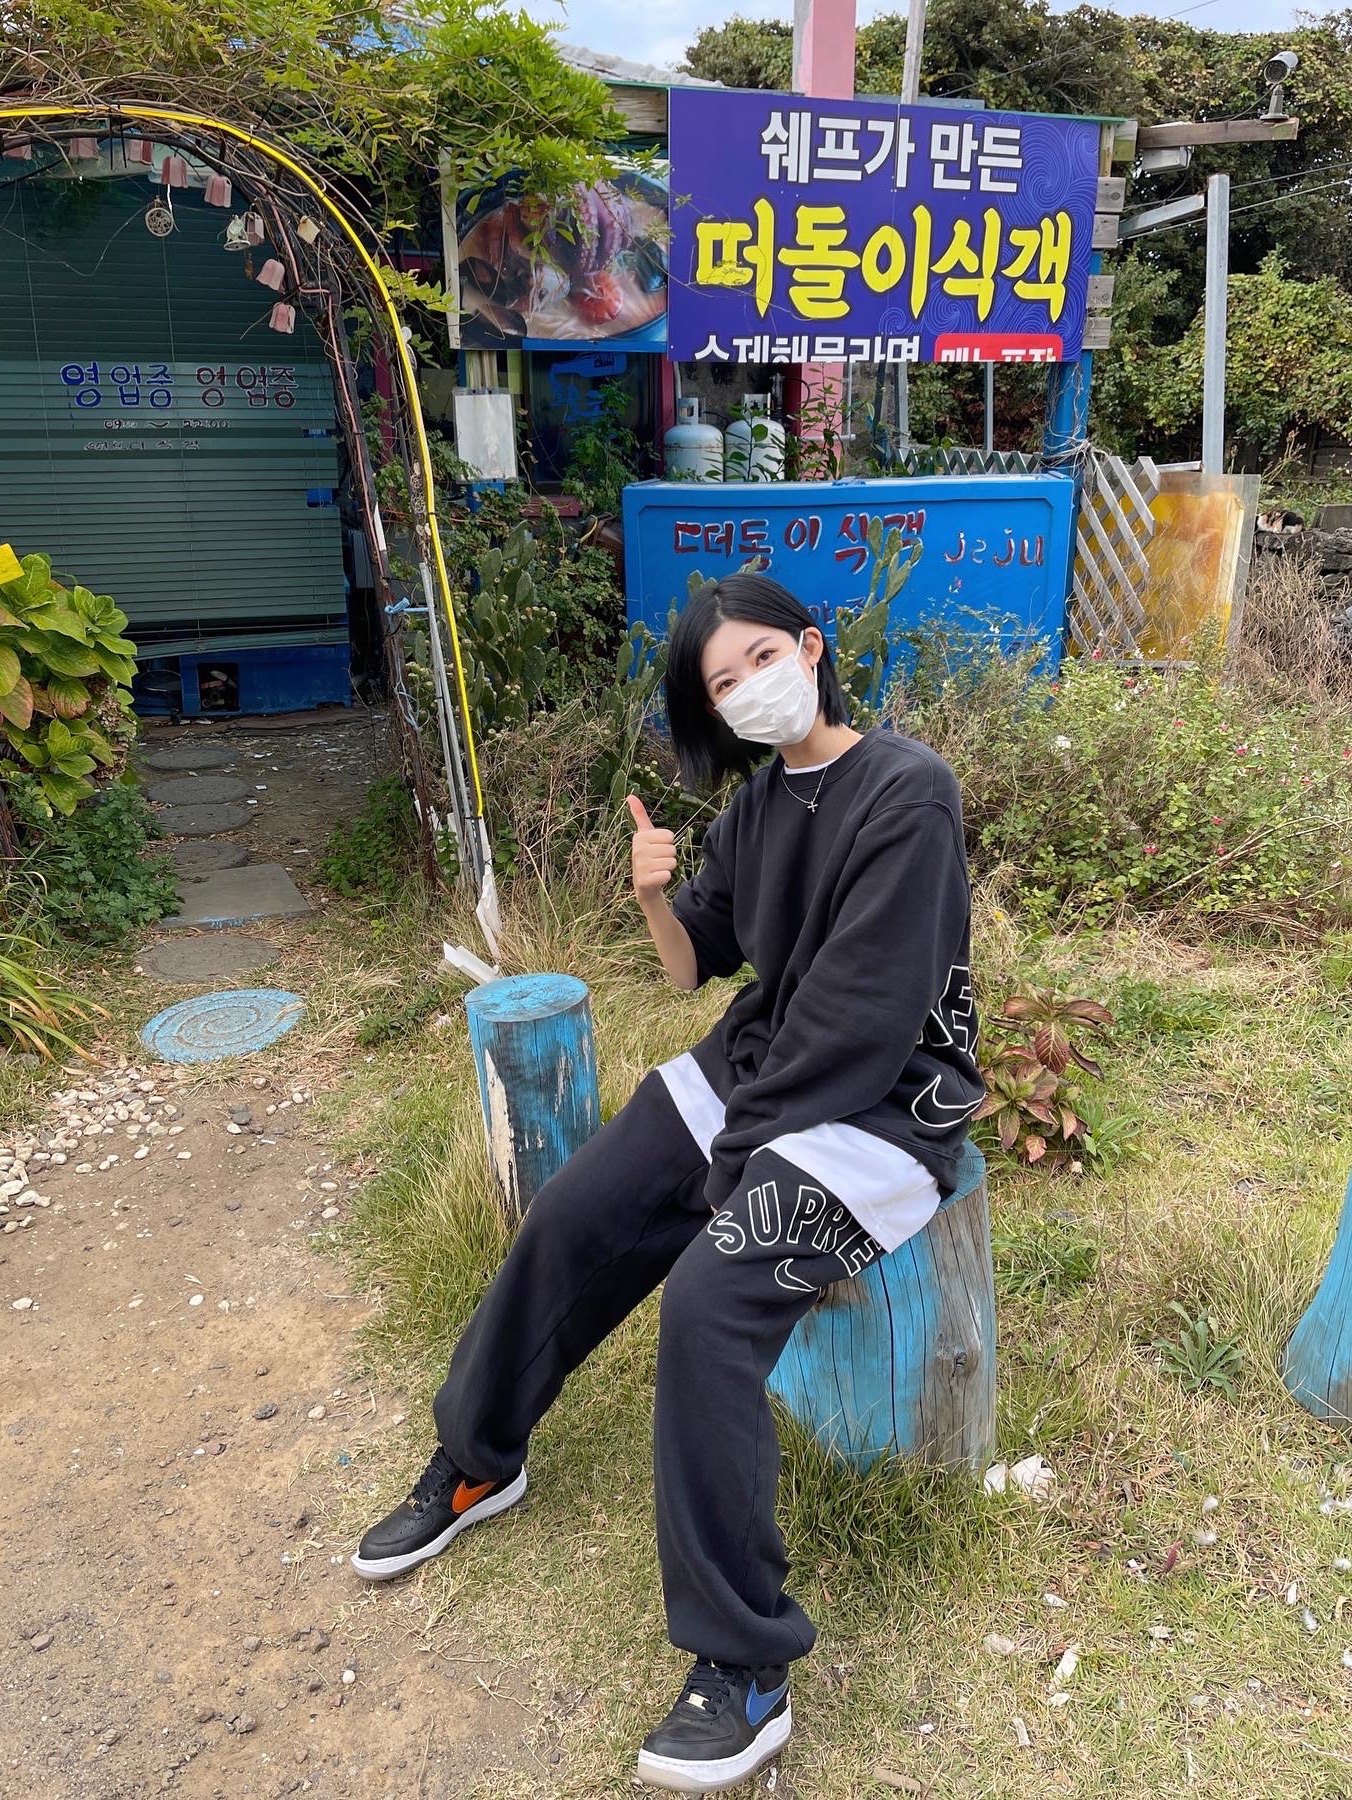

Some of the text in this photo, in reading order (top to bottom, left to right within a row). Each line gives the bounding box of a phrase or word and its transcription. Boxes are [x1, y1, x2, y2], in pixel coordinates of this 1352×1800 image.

[761, 111, 1023, 193] 쉐프가 만든
[60, 361, 174, 408] 영업중
